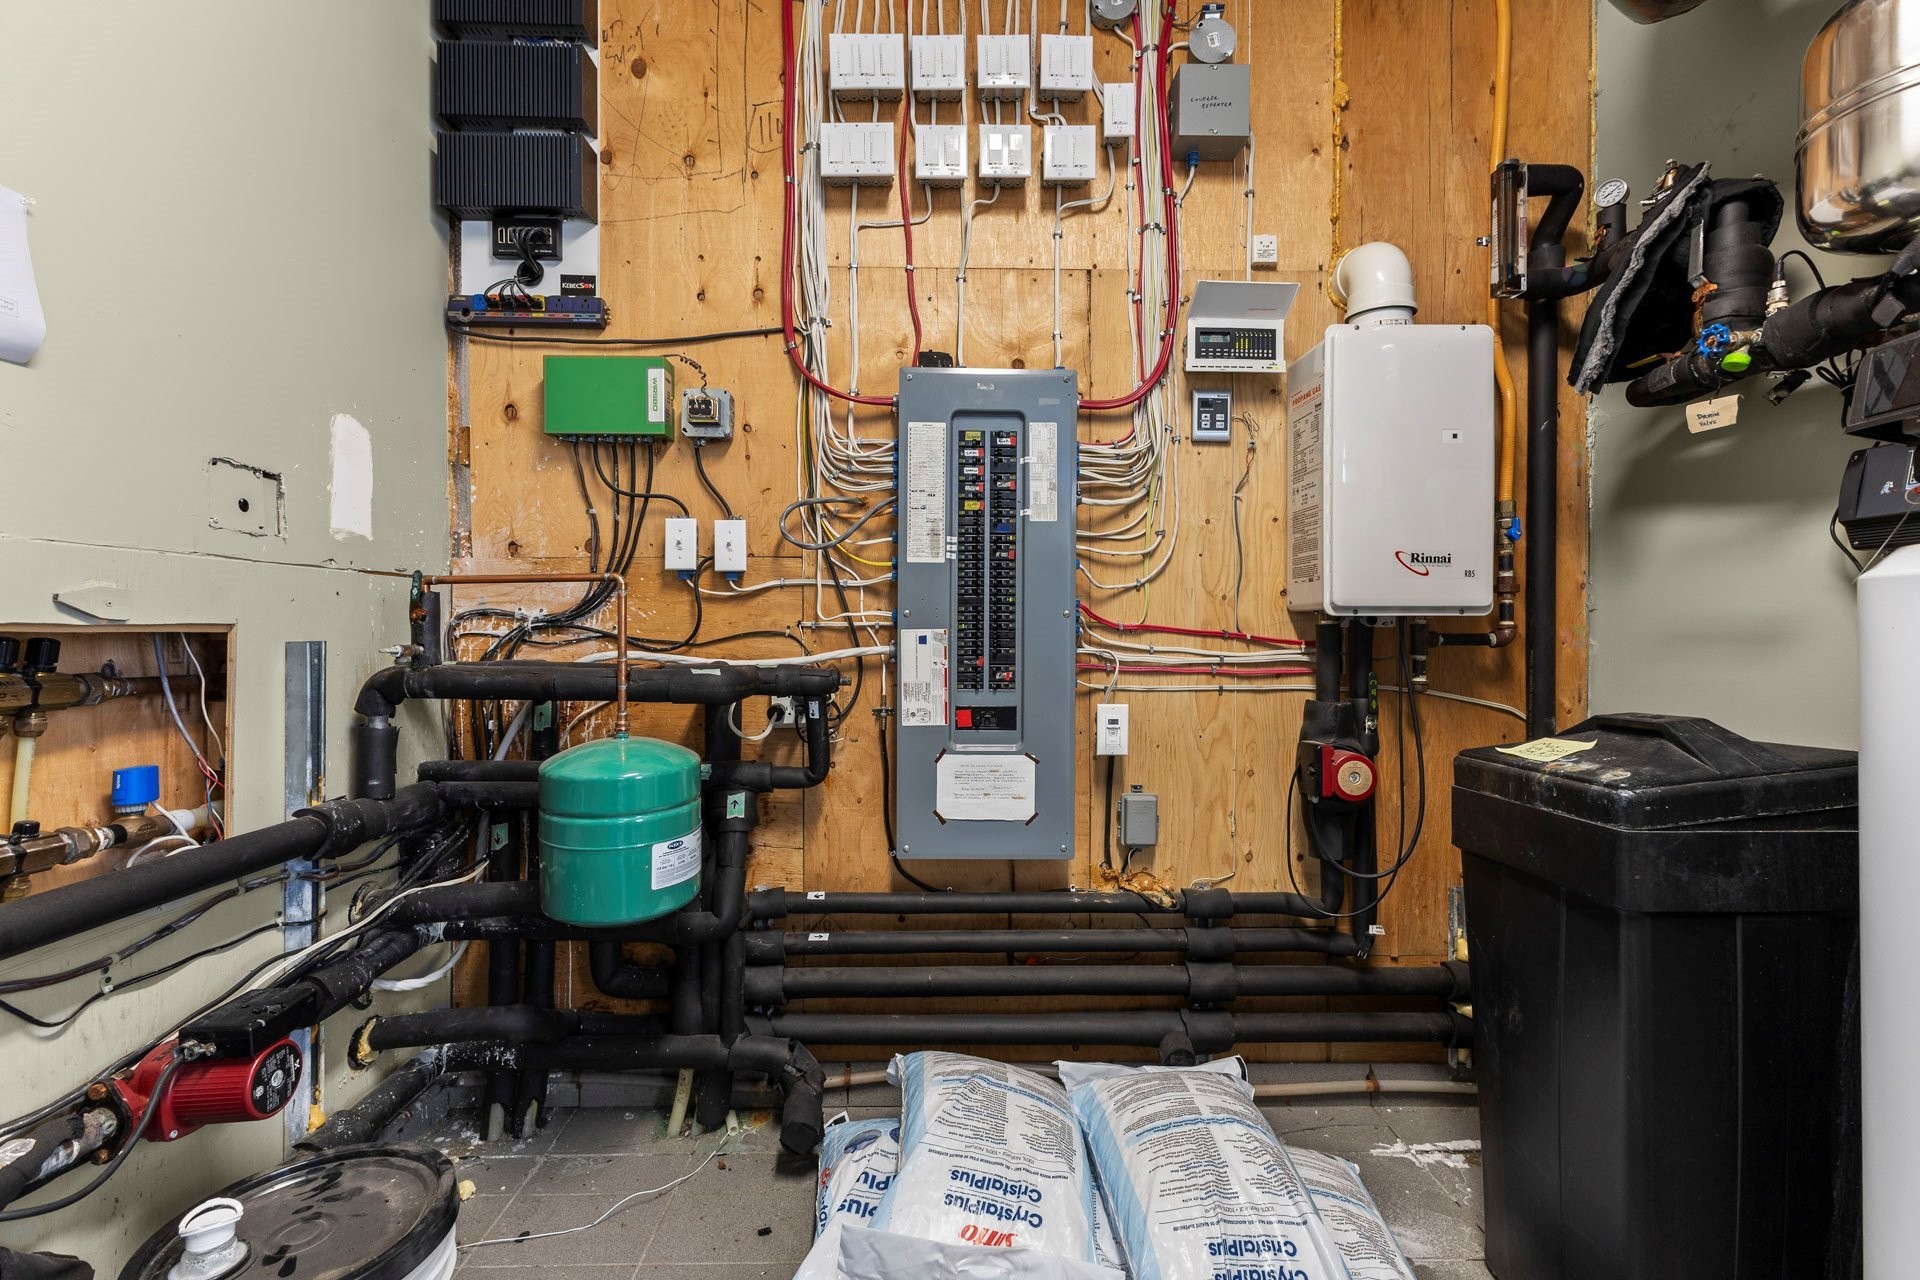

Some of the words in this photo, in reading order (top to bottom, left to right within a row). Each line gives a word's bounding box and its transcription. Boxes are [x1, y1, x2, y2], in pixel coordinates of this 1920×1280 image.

[1410, 552, 1452, 564] Rinnai
[950, 1169, 1042, 1203] CristalPlus
[944, 1193, 1043, 1229] CrystalPlus
[1208, 1237, 1298, 1257] CristalPlus
